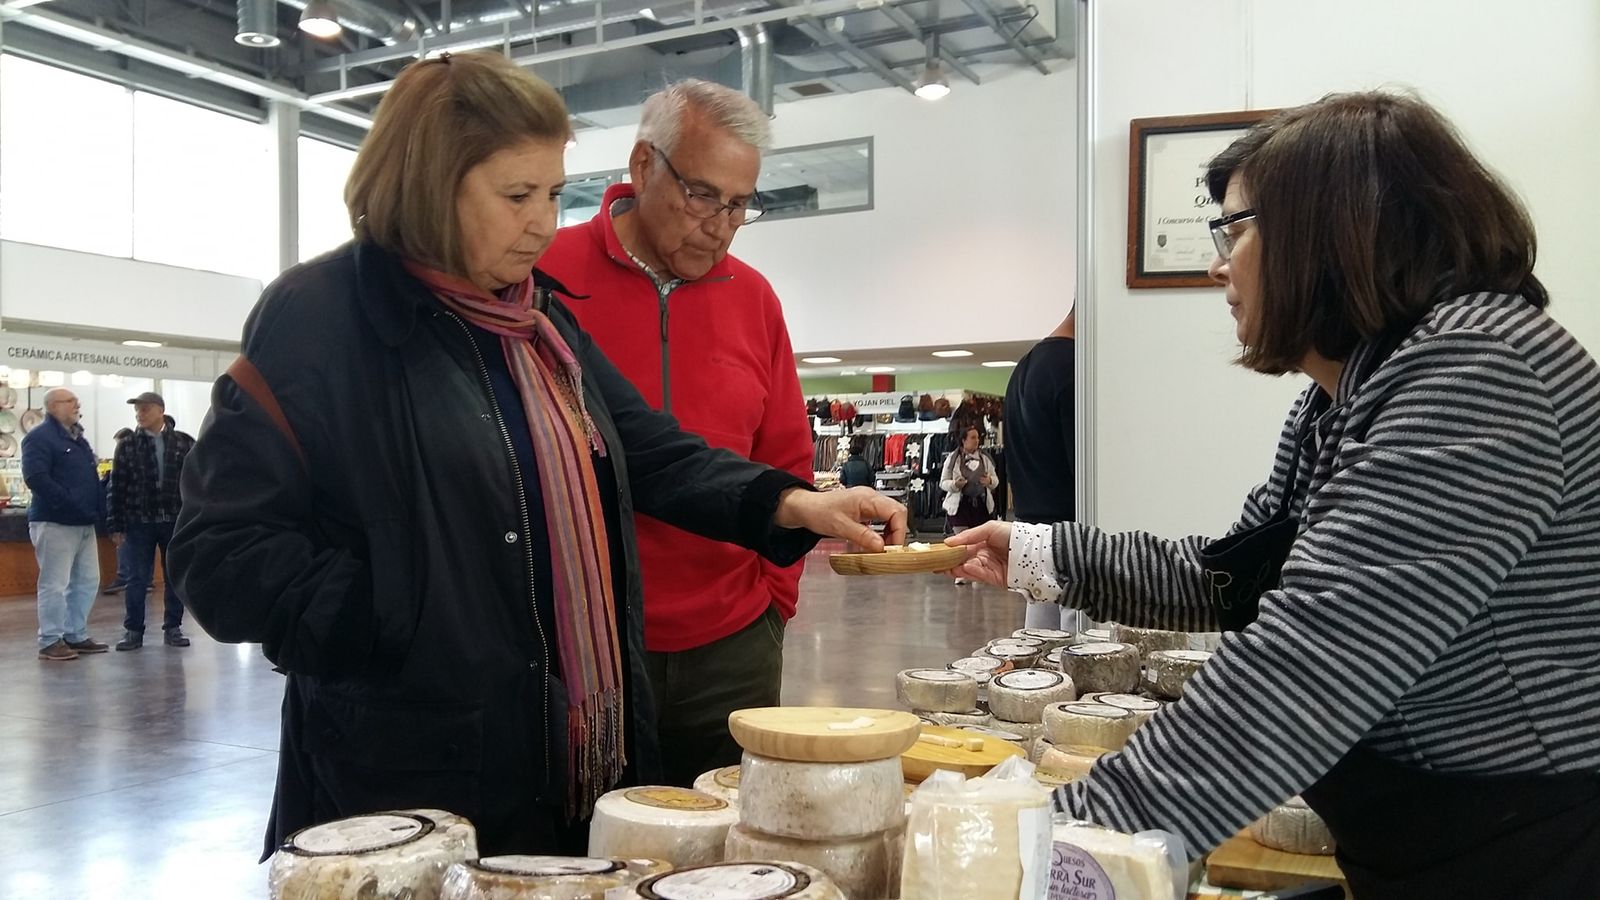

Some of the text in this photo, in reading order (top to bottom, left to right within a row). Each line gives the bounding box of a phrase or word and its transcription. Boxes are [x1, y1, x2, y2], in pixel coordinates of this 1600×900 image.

[1163, 216, 1194, 225] Concurso
[1195, 215, 1204, 223] de
[7, 346, 169, 369] CERÁMICA ARTESANAL CÓRDOBA
[854, 398, 895, 407] YOJAN PIEL
[1050, 869, 1069, 883] RRA
[1049, 881, 1058, 891] in
